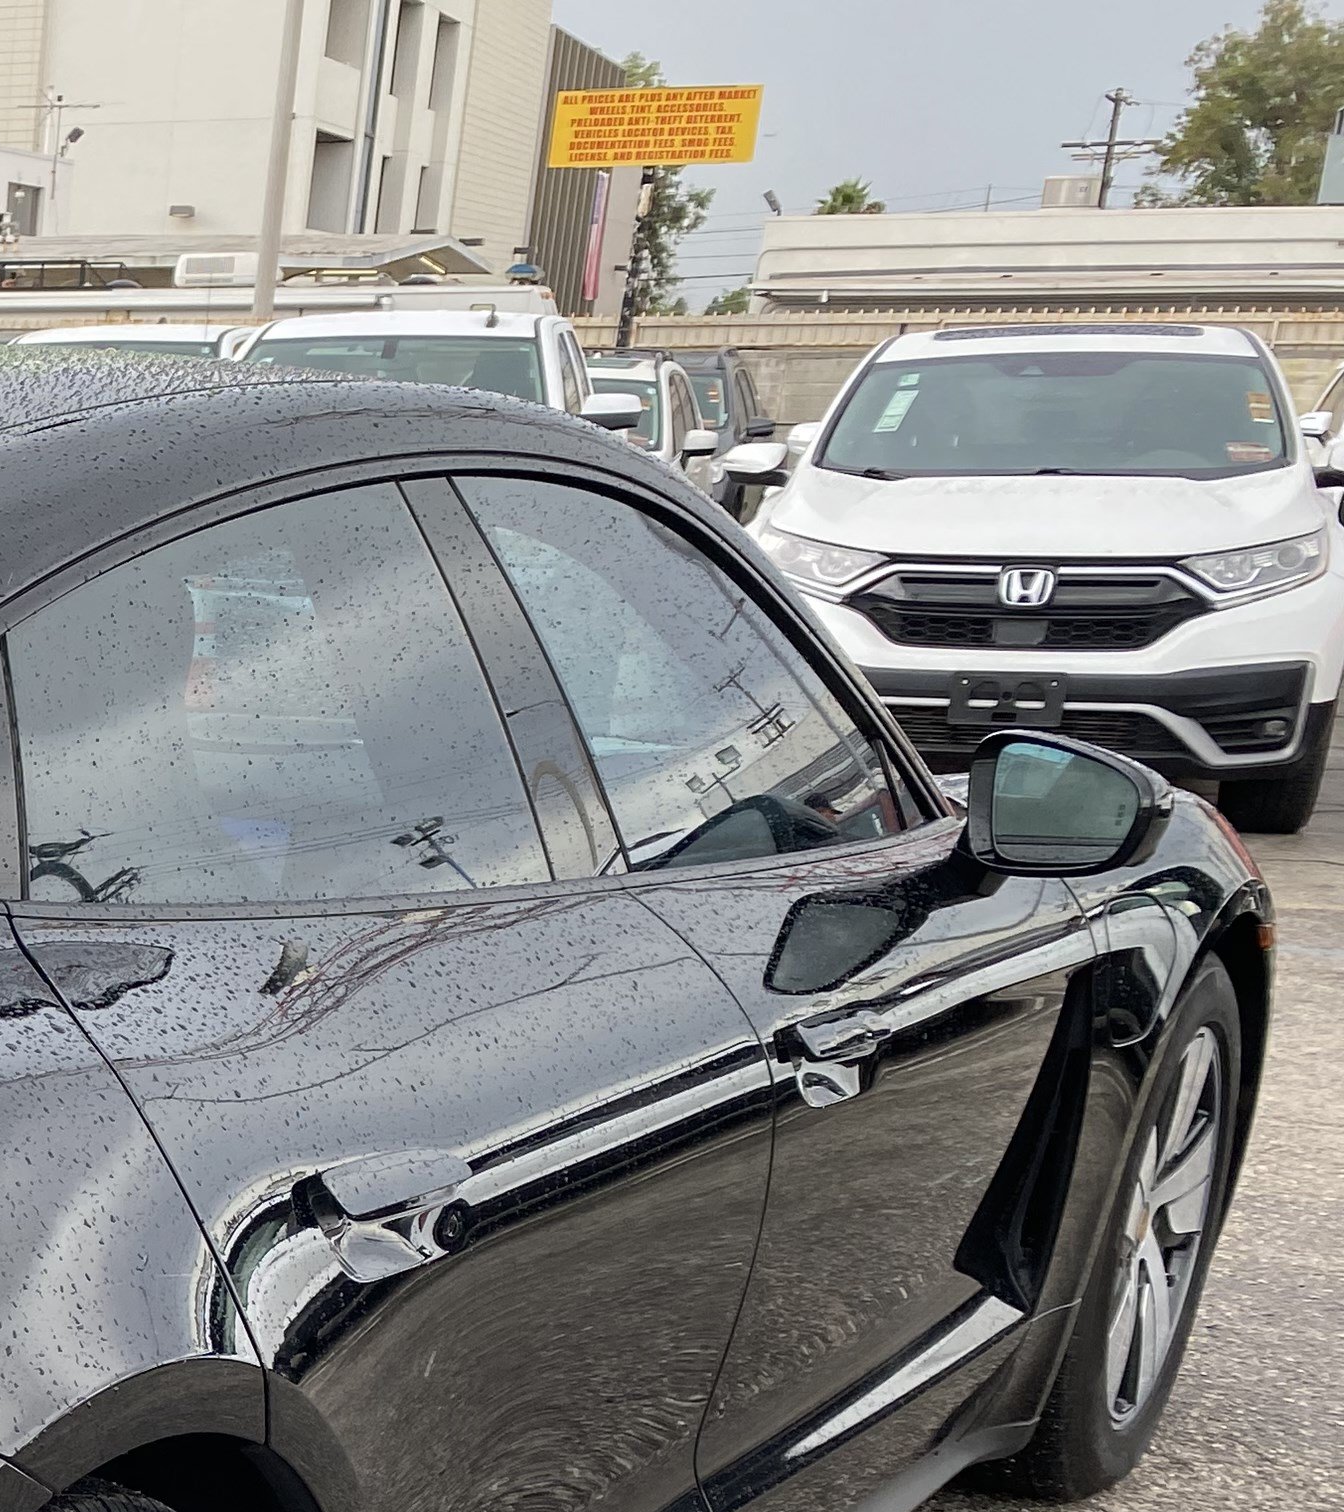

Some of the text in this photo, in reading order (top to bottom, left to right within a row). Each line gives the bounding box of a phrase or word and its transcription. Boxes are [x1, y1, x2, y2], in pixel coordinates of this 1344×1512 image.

[562, 89, 758, 105] ALL PRICES ARE PLUS ANY AFTER MARKET
[570, 117, 625, 127] PRELOADED
[574, 128, 620, 139] VEHICLES
[622, 127, 664, 138] LOCATOR
[569, 140, 651, 151] DOCUMENTATION
[613, 151, 633, 161] AND
[635, 150, 707, 160] REGISTRATION
